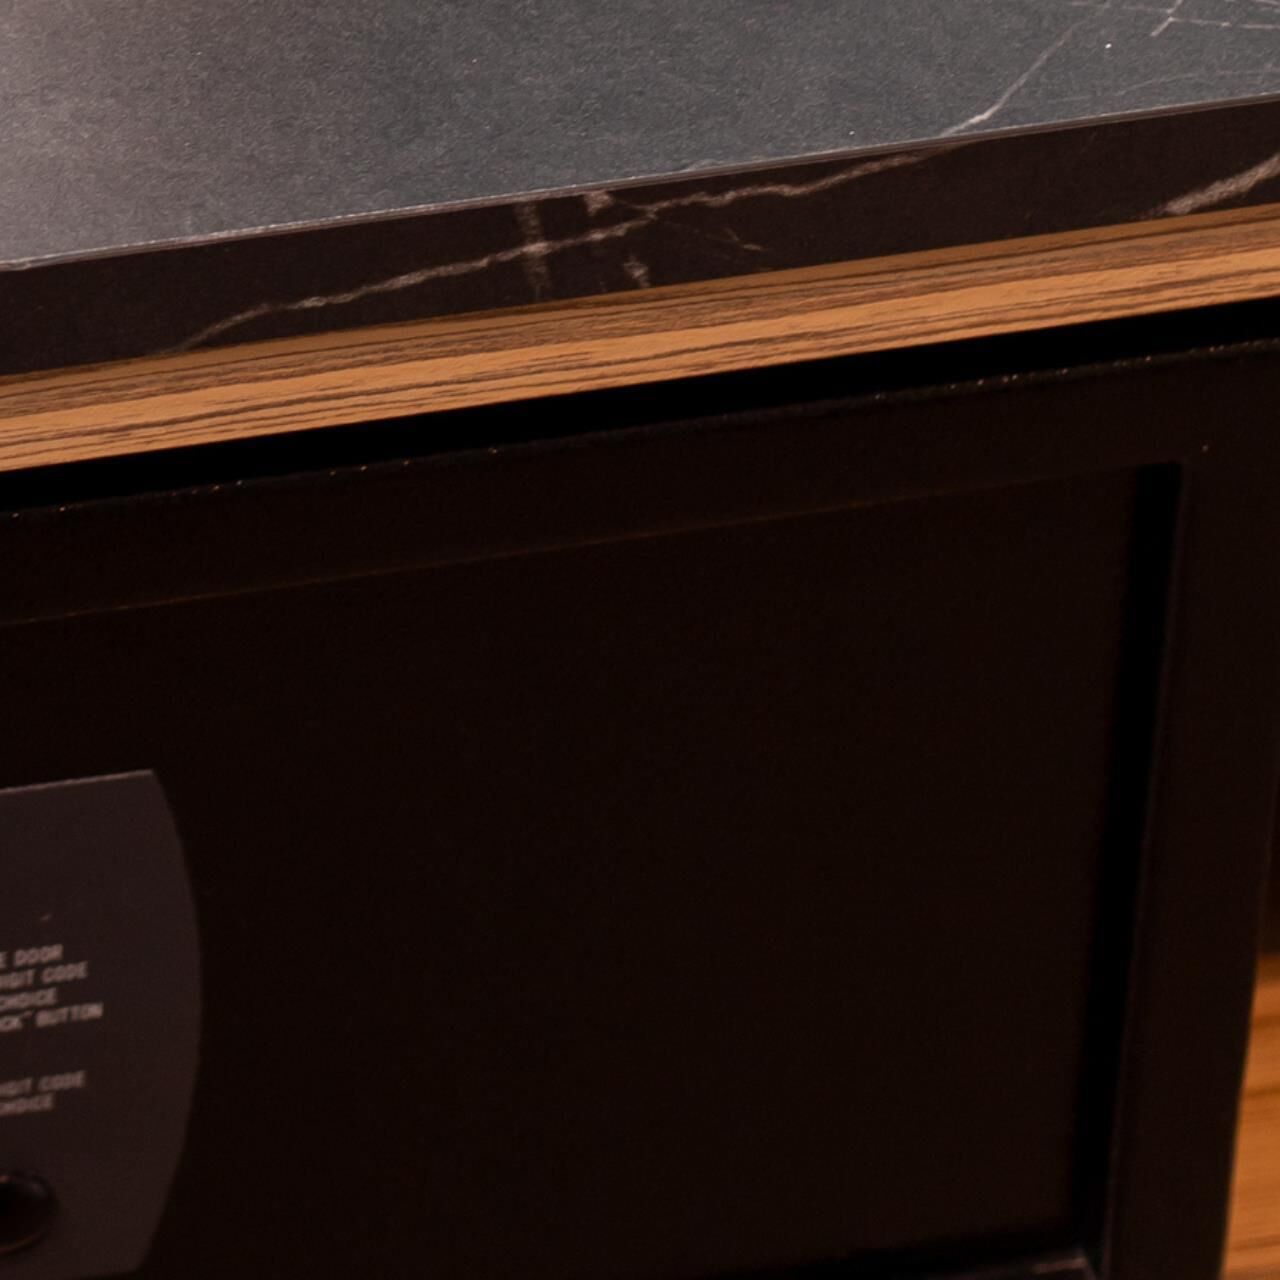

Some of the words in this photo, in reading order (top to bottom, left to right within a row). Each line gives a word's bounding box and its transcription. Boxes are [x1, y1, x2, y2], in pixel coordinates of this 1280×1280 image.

[14, 943, 63, 966] DOOR
[42, 961, 88, 984] CODE
[36, 1002, 104, 1028] BUTTON
[39, 1070, 85, 1091] CODE
